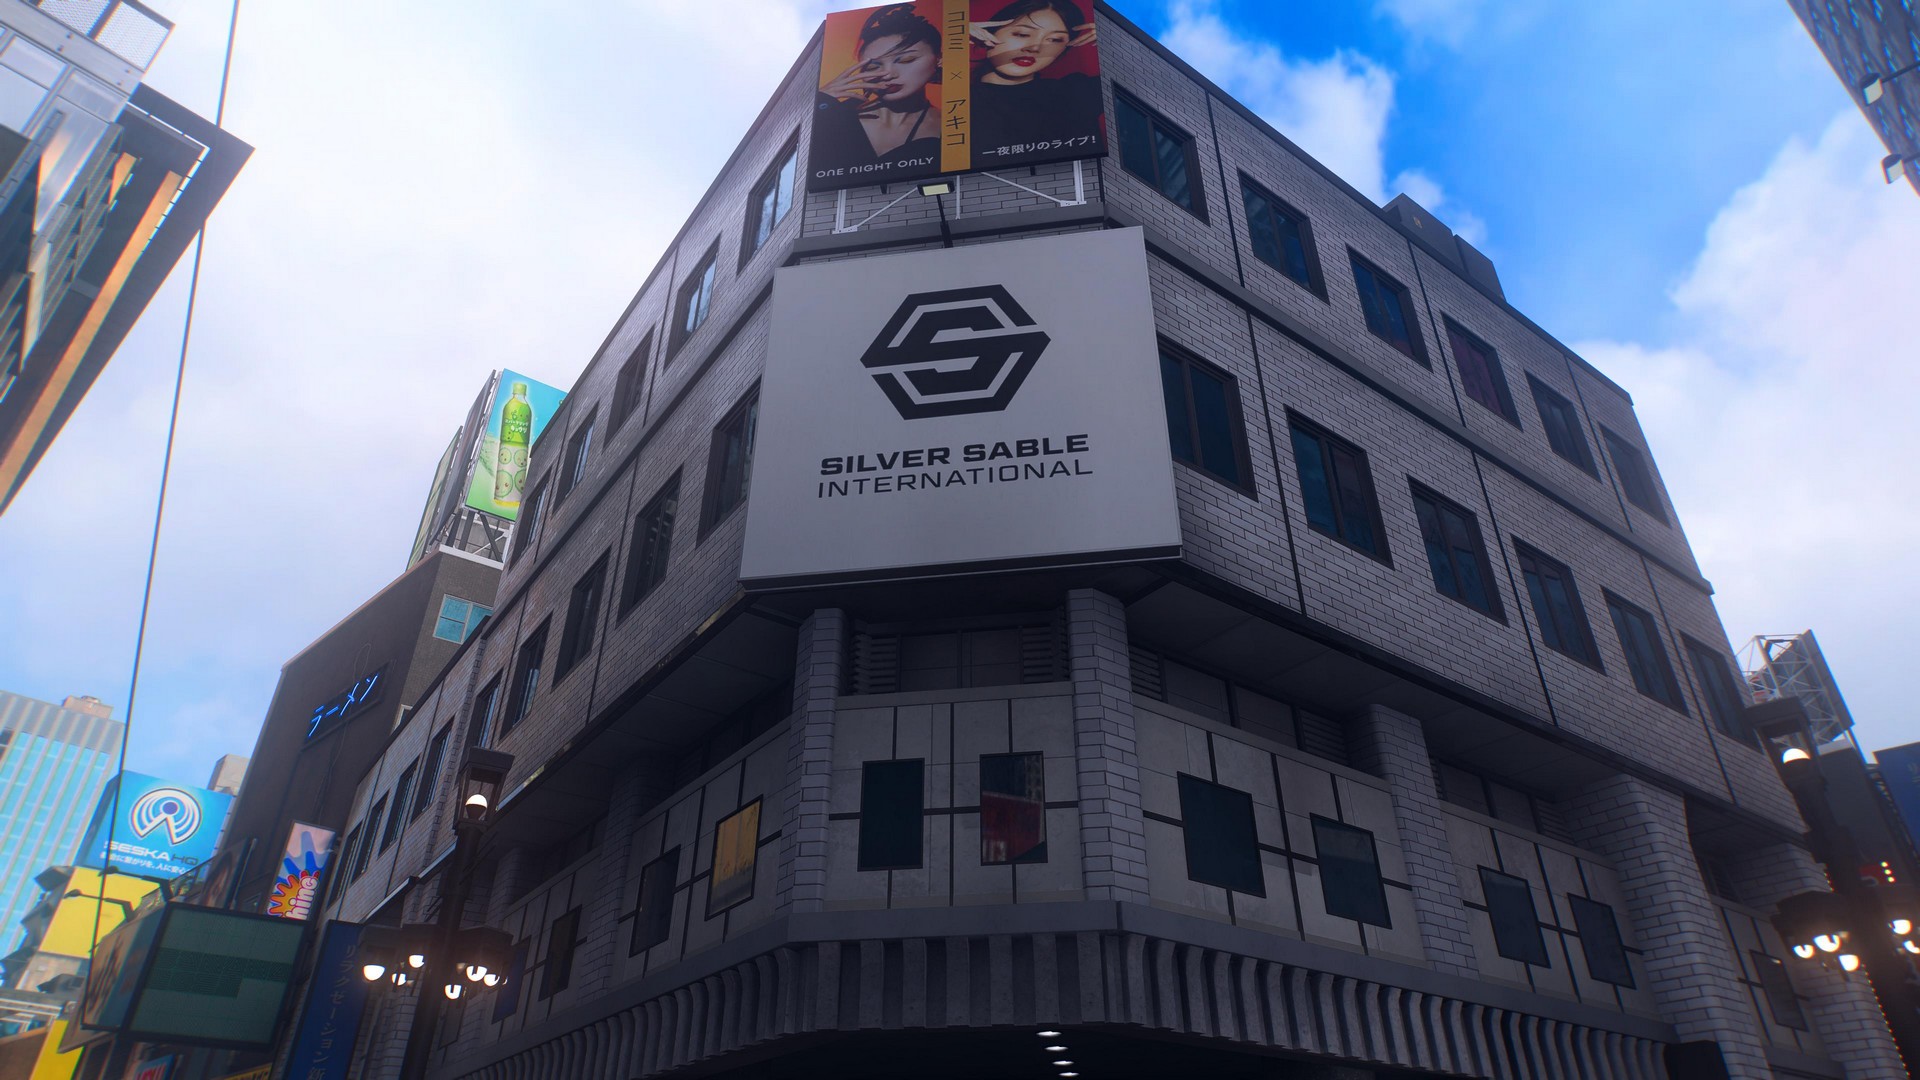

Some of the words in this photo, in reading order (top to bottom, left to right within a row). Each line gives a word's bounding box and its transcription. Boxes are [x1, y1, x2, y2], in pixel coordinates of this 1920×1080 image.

[948, 11, 965, 50] ココミ
[946, 99, 967, 146] アキコ
[820, 446, 950, 475] SILVER
[963, 434, 1090, 463] SABLE
[818, 459, 1093, 498] INTERNATIONAL
[308, 673, 379, 738] ラーメン
[103, 840, 171, 862] SESKA
[171, 853, 199, 867] HQ
